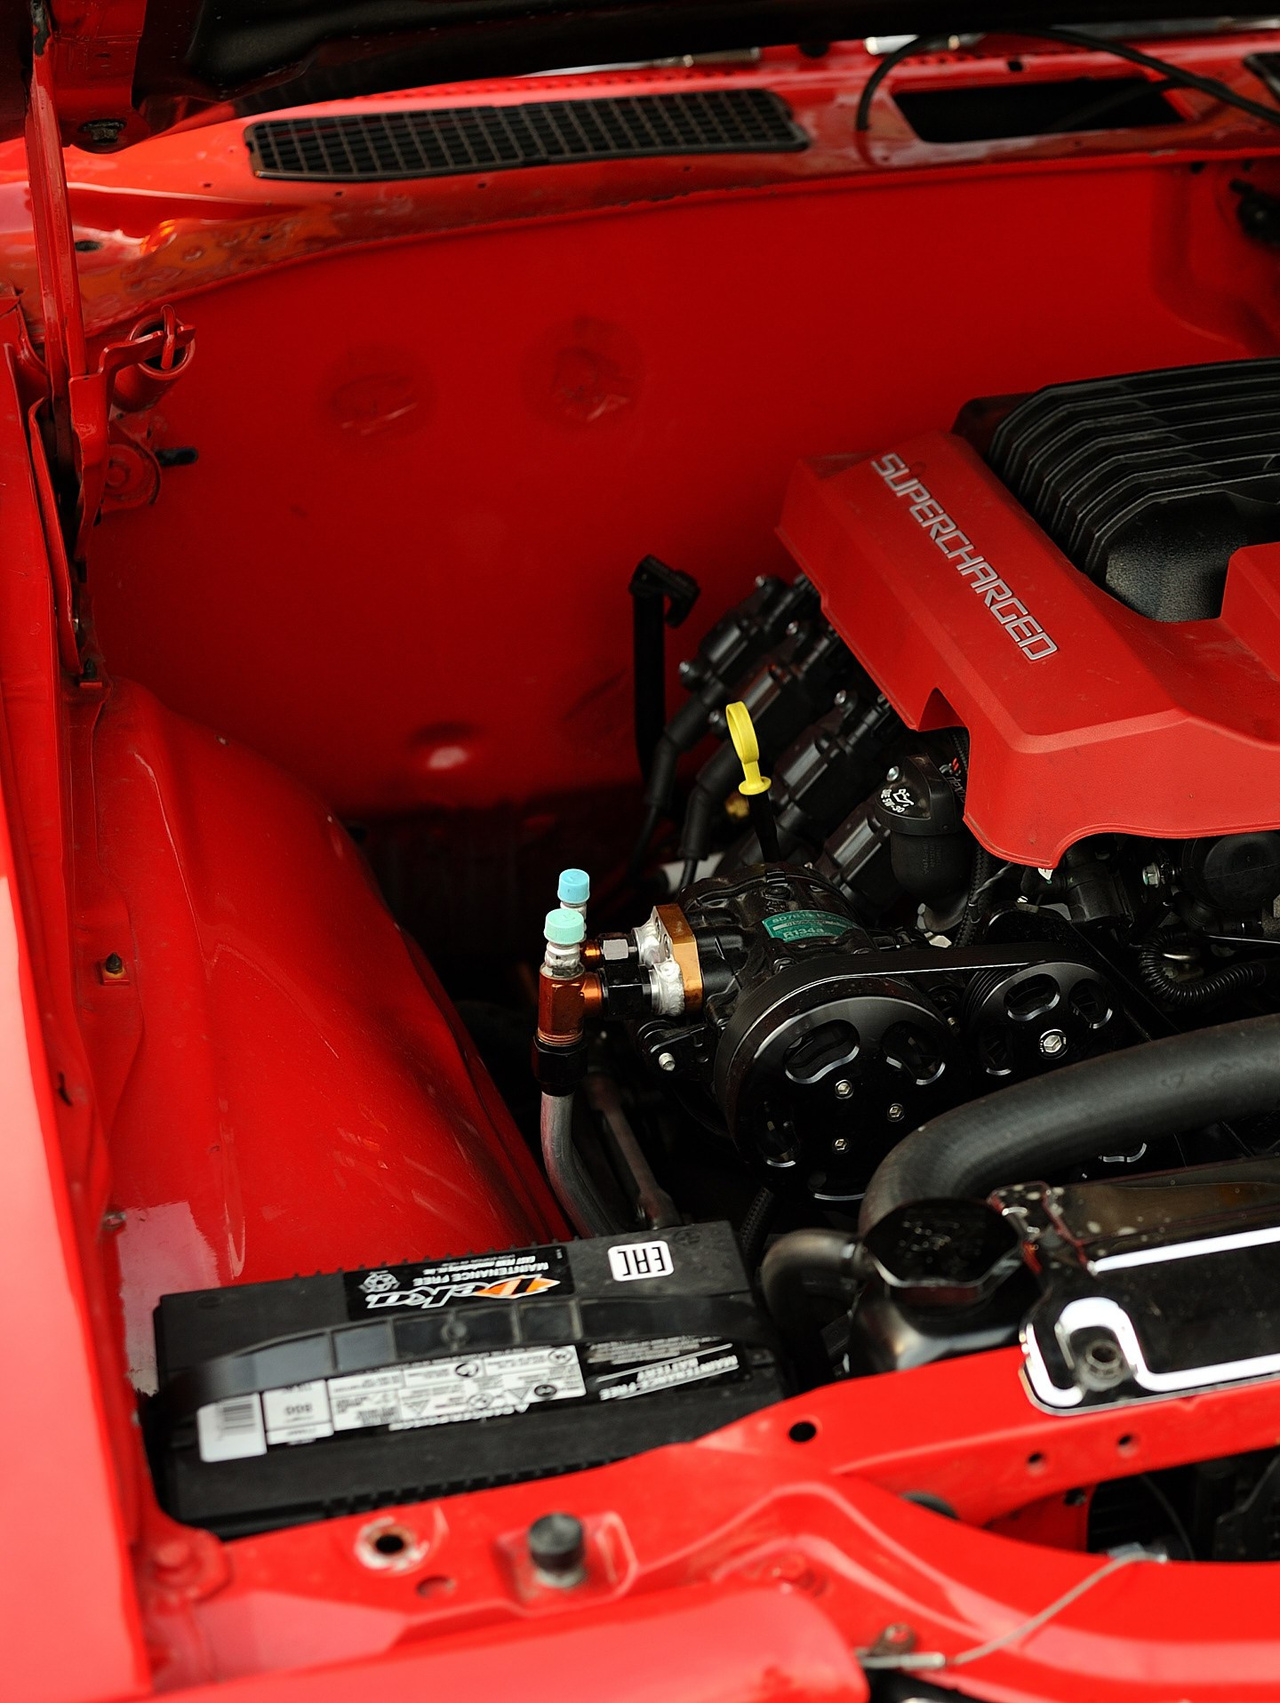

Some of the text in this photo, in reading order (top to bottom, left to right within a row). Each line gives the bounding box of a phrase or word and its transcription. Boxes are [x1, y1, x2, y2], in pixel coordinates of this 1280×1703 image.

[870, 452, 1059, 662] SUPERCHARGED
[412, 1262, 549, 1287] MAINTENANCE FREE
[617, 1246, 666, 1277] EAC
